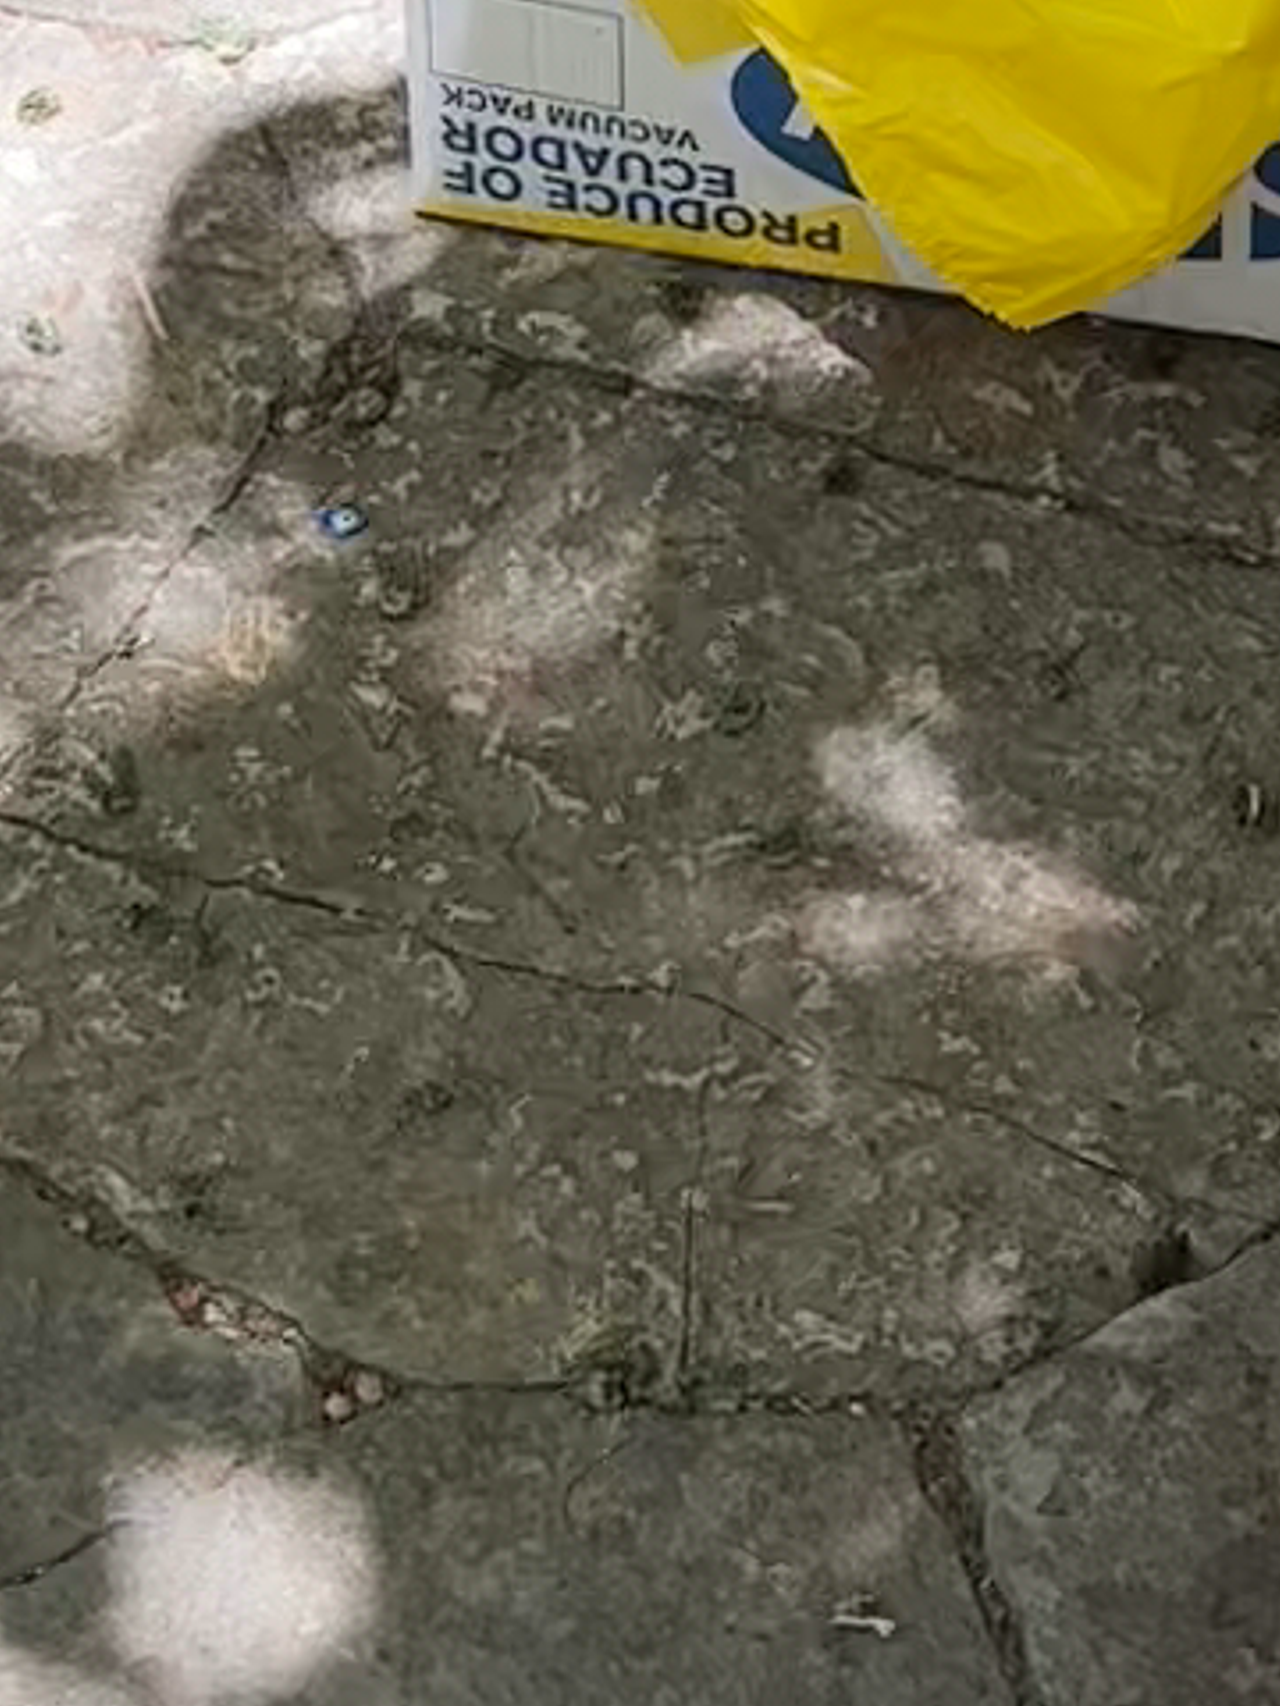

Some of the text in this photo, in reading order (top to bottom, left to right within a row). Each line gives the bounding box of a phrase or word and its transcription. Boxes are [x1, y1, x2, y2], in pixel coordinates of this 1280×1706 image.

[439, 82, 700, 153] VACUUM PACK
[441, 115, 737, 199] ECUADOR
[442, 159, 843, 254] PRODUCE OF
